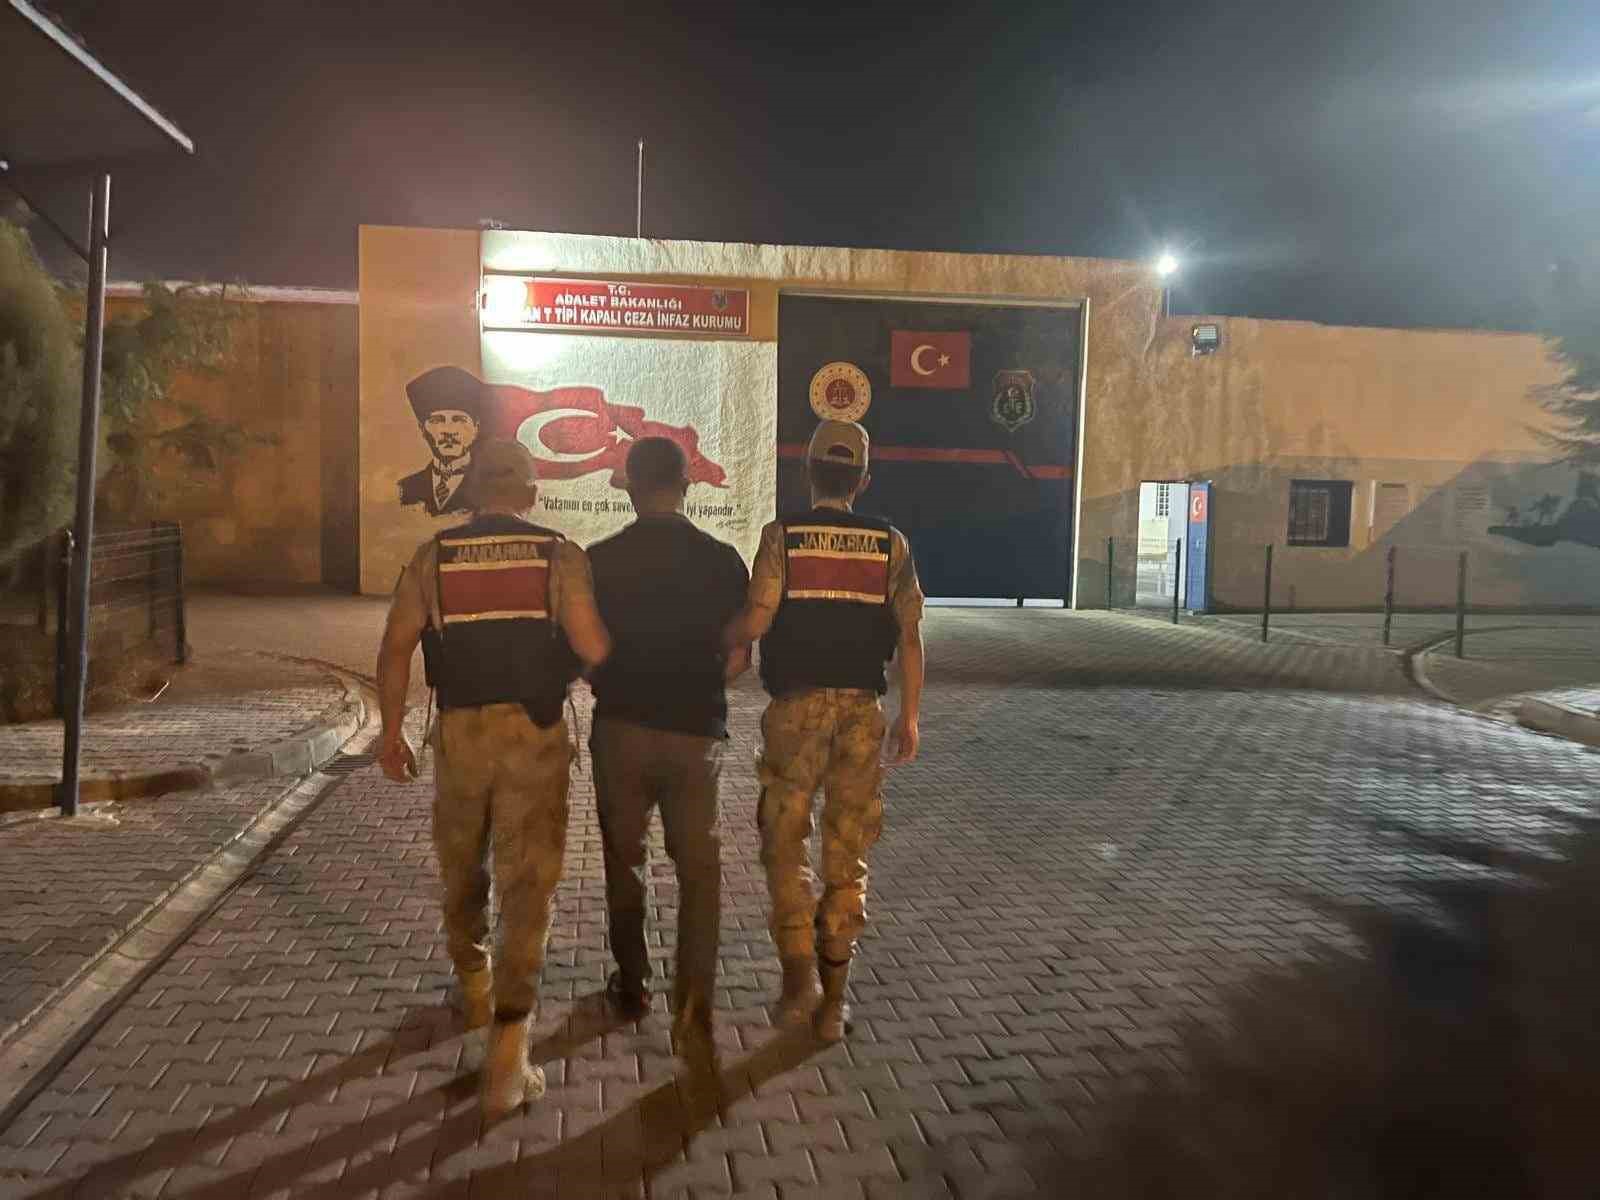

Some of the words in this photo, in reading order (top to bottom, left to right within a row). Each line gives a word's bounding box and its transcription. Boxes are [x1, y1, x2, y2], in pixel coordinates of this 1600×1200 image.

[555, 293, 607, 307] ADALET
[610, 296, 682, 311] BAKANLIĞI
[544, 307, 553, 322] T
[555, 305, 577, 323] TİPİ
[580, 308, 621, 325] KAPALI
[623, 311, 654, 326] CEZA
[657, 310, 690, 328] İNFAZ
[692, 314, 742, 329] KURUMU
[582, 501, 592, 511] en
[594, 498, 609, 515] çok
[687, 502, 697, 517] iyi
[800, 531, 881, 554] JANDARMA
[453, 543, 539, 563] JANDARMA
